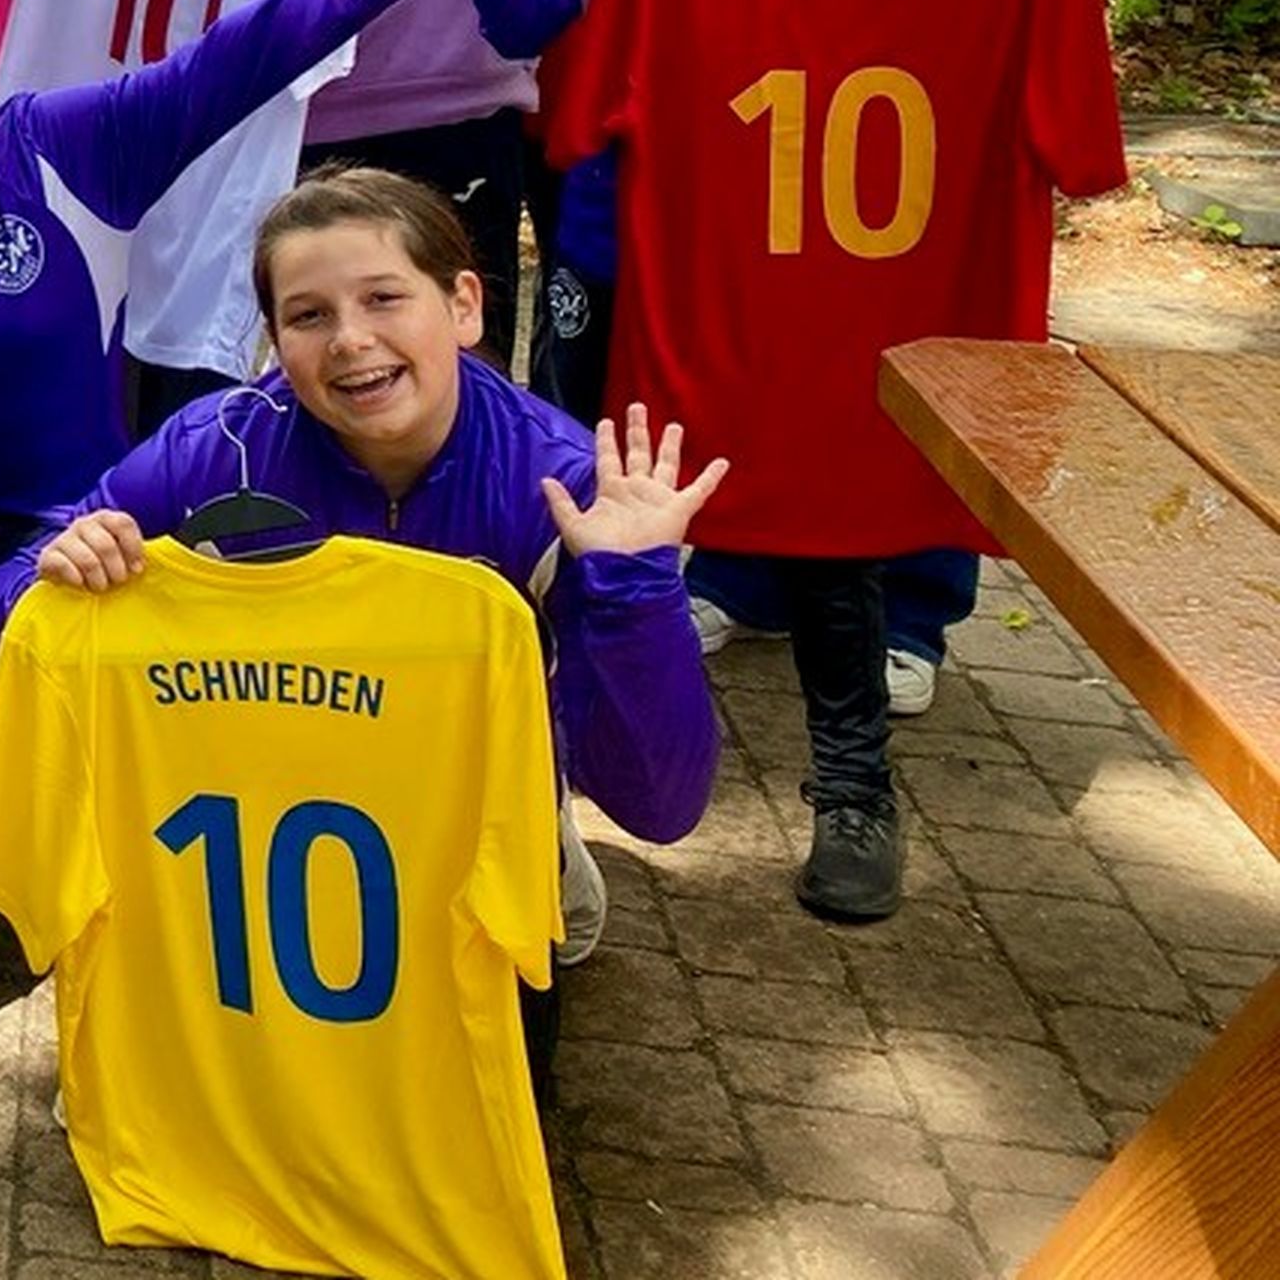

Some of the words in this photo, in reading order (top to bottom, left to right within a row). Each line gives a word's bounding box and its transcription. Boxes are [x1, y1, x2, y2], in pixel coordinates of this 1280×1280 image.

[729, 66, 937, 259] 10
[149, 660, 384, 718] SCHWEDEN
[153, 793, 400, 1024] 10
